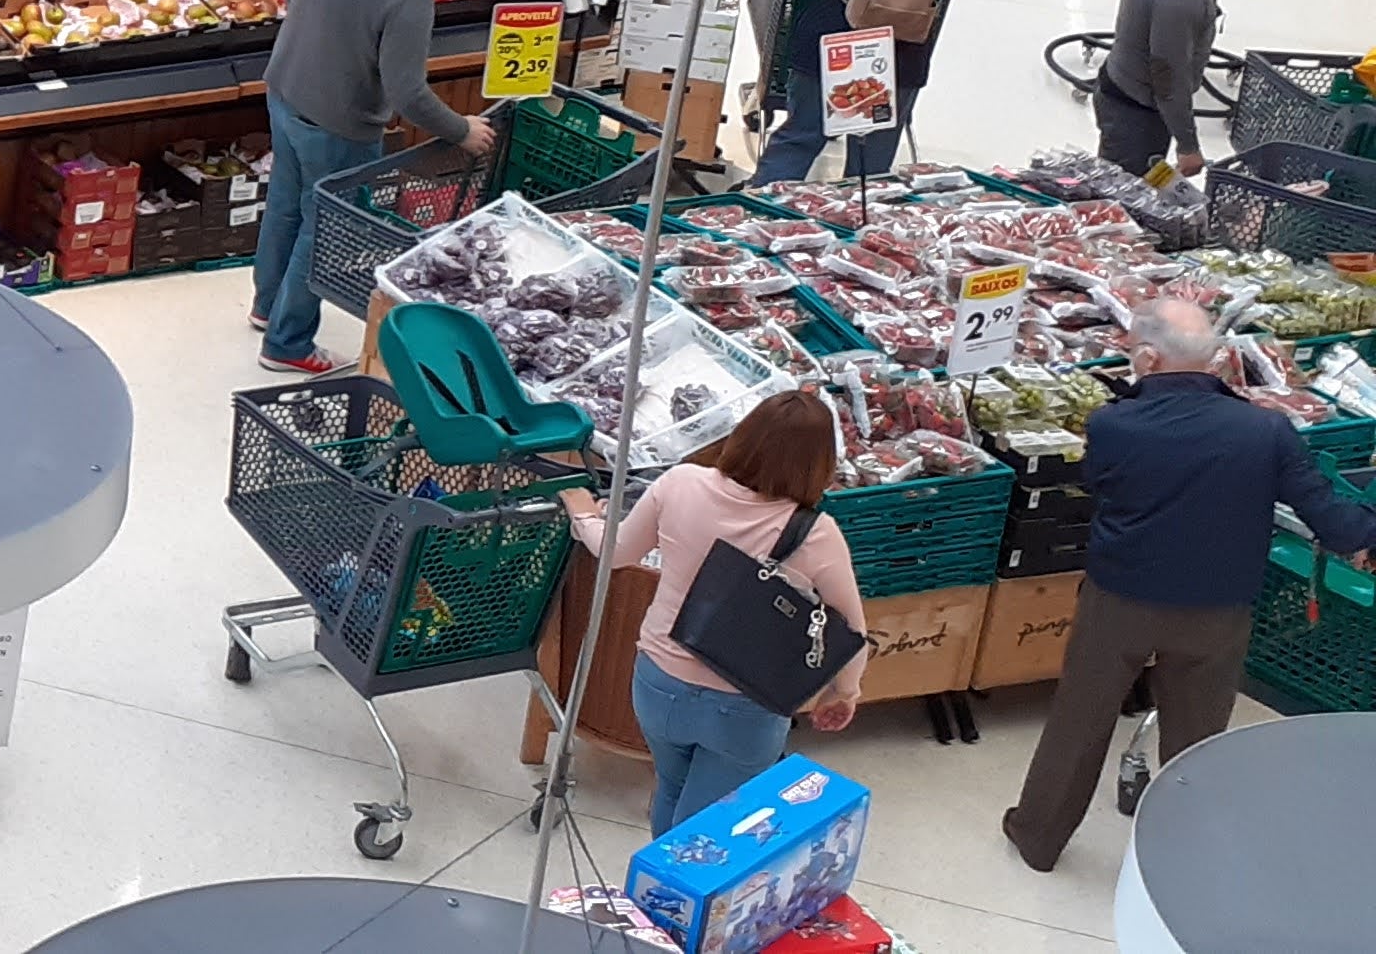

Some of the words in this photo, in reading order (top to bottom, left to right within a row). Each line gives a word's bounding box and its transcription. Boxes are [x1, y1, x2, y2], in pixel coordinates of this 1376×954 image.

[499, 6, 558, 22] APROVEITE!
[502, 59, 550, 80] 2,39
[964, 305, 1015, 342] 2,99
